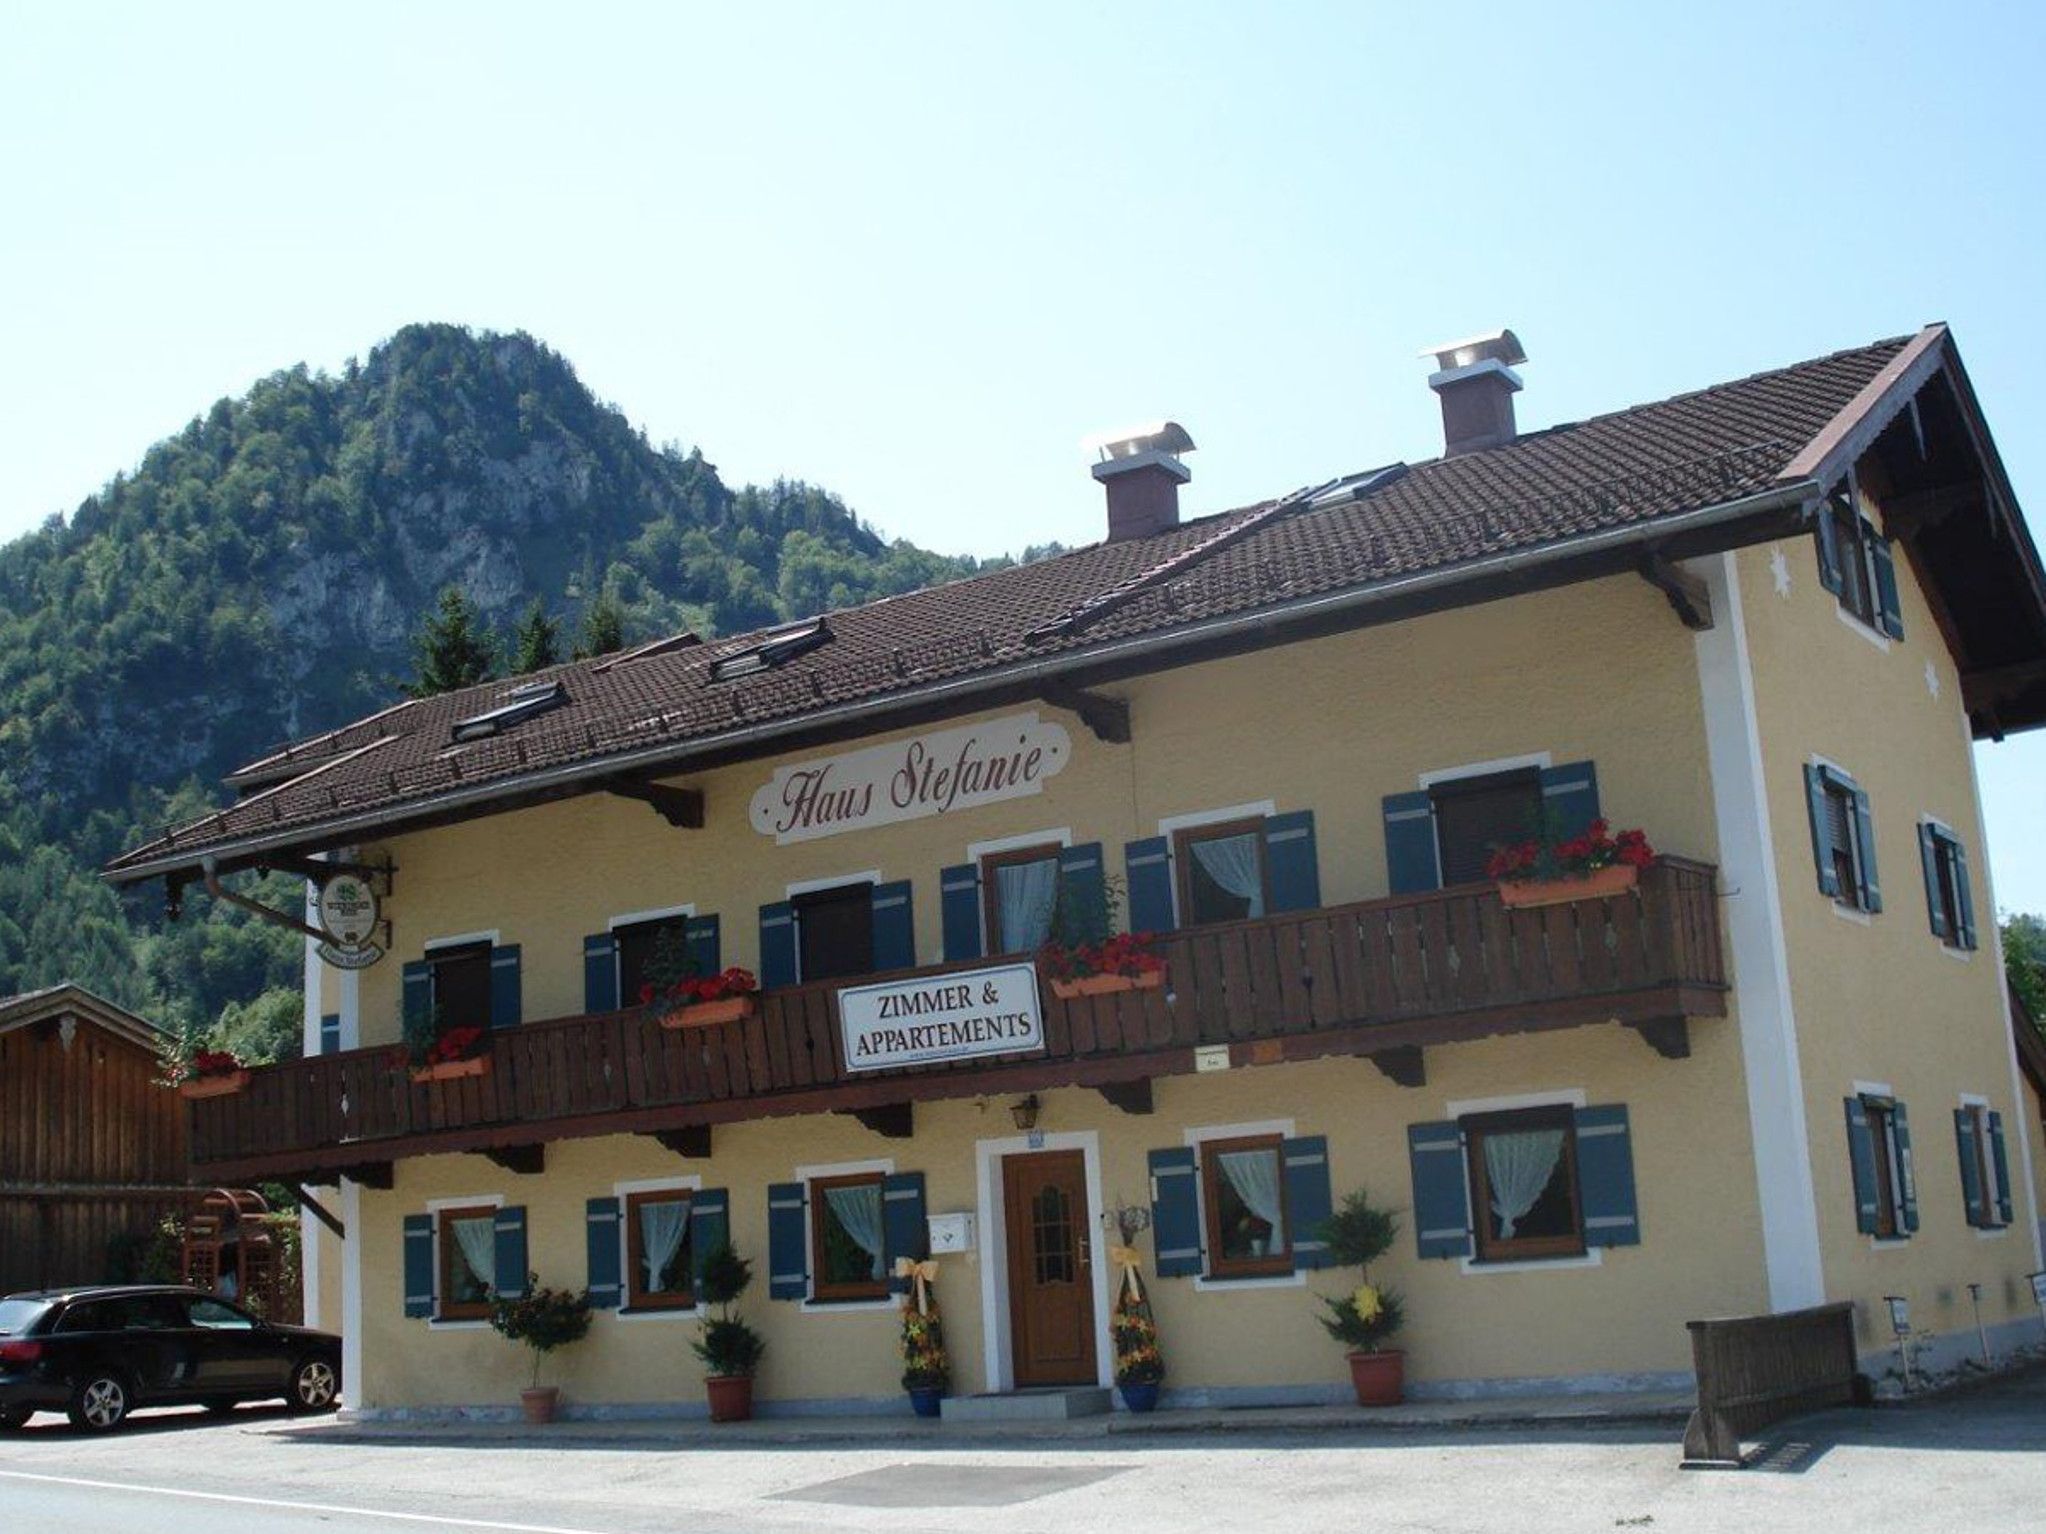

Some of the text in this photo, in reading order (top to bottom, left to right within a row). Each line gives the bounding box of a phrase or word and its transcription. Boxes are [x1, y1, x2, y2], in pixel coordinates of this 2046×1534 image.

[776, 734, 1042, 833] Haus Stefanie
[878, 981, 999, 1019] ZIMMER &
[857, 1012, 1032, 1056] APPARTEMENTS
